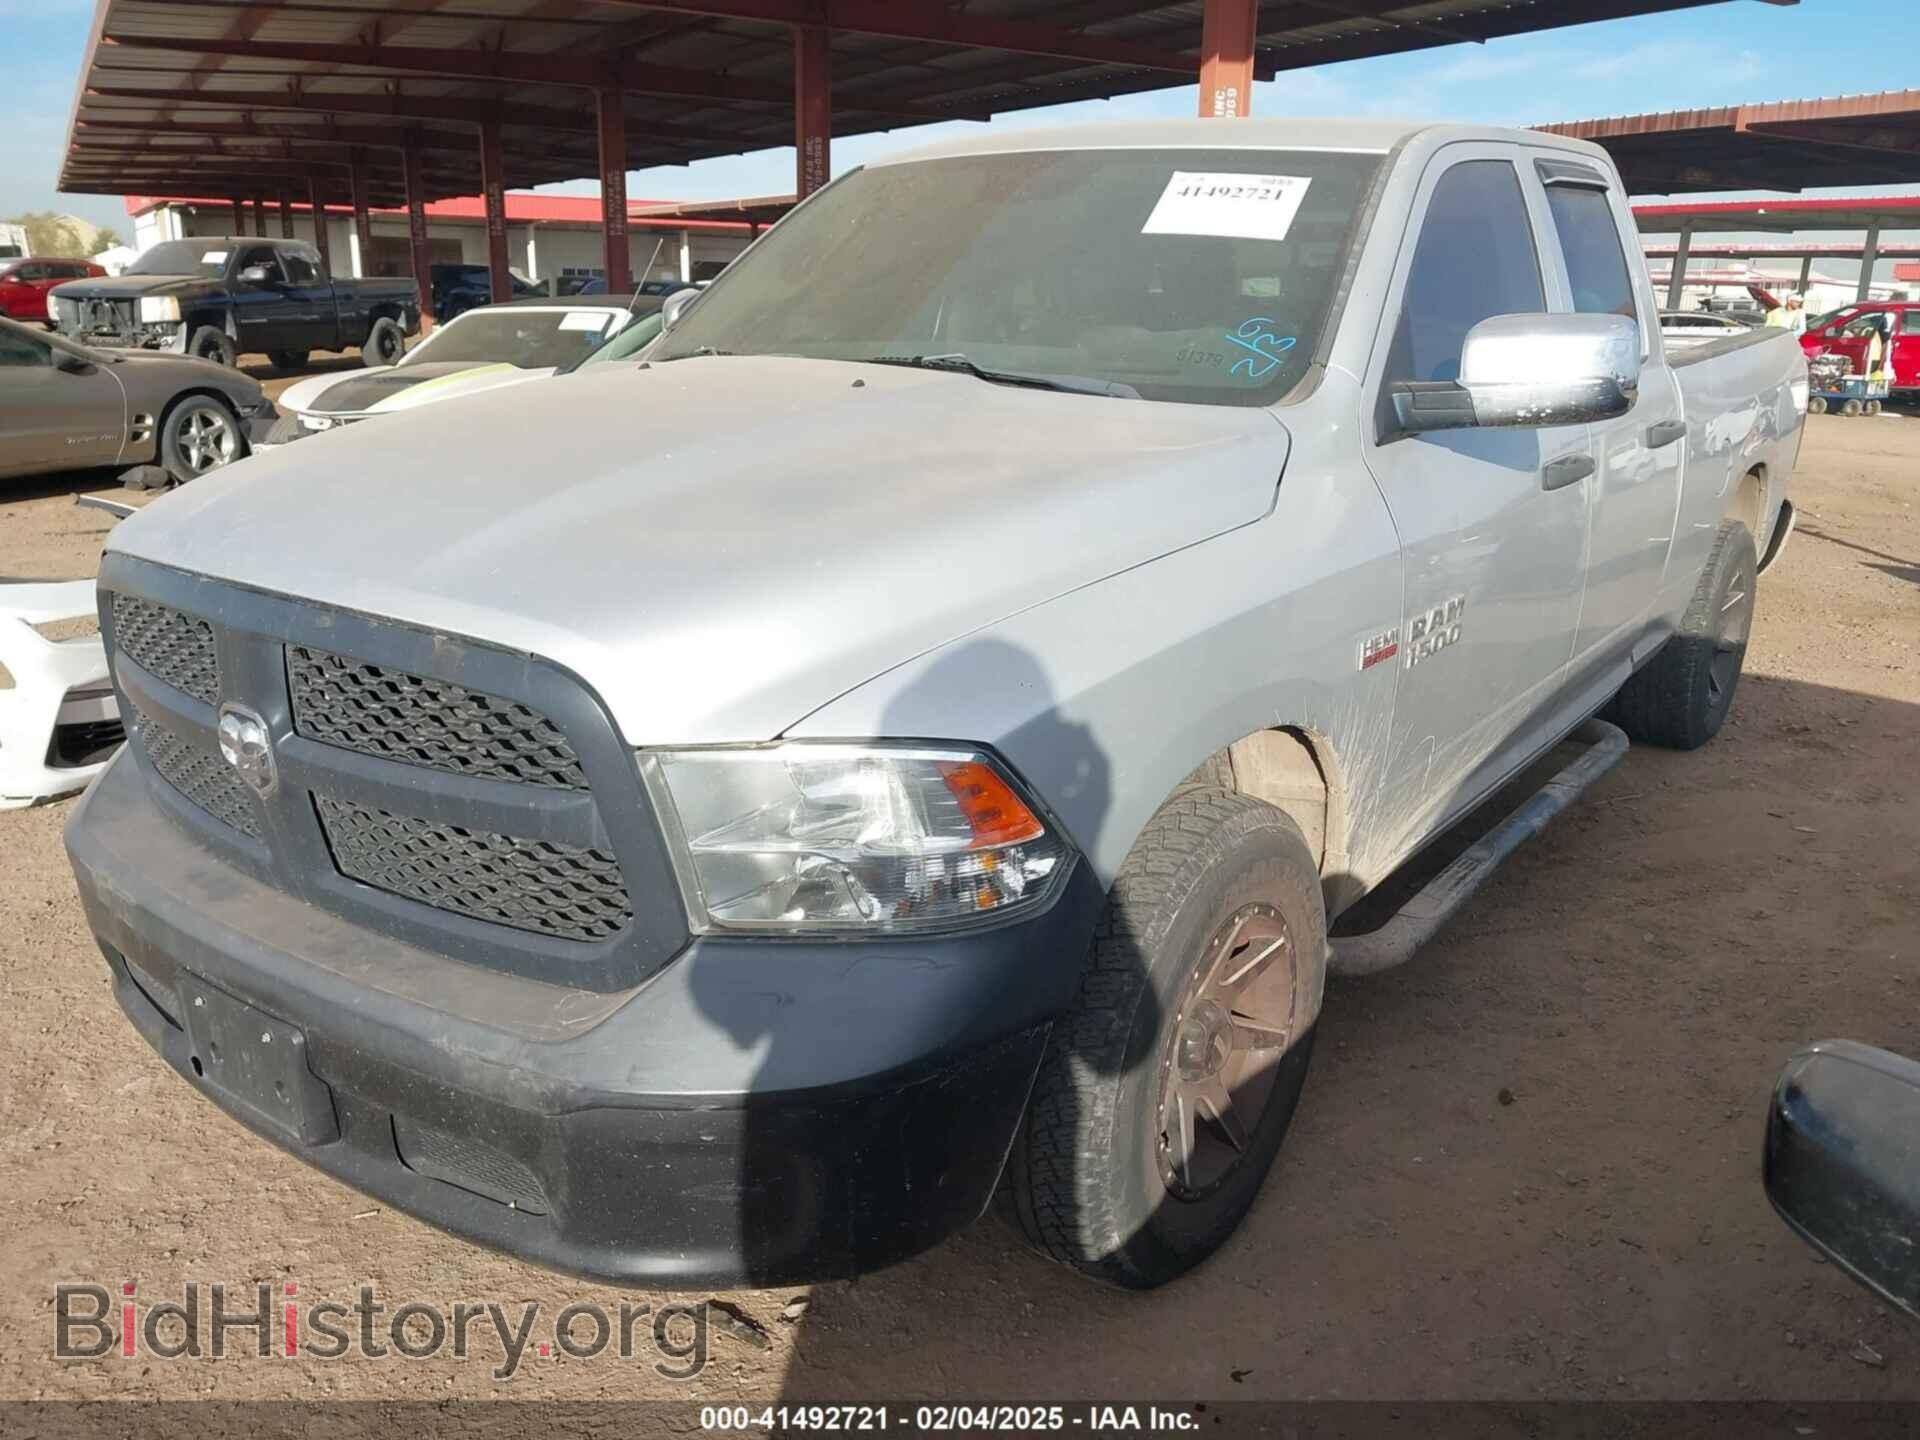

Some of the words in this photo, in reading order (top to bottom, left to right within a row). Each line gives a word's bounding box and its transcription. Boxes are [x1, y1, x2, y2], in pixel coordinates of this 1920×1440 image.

[1176, 186, 1284, 200] 41492721
[1408, 592, 1465, 643] RAM
[1358, 626, 1400, 672] HEMI
[1405, 621, 1462, 670] 1500
